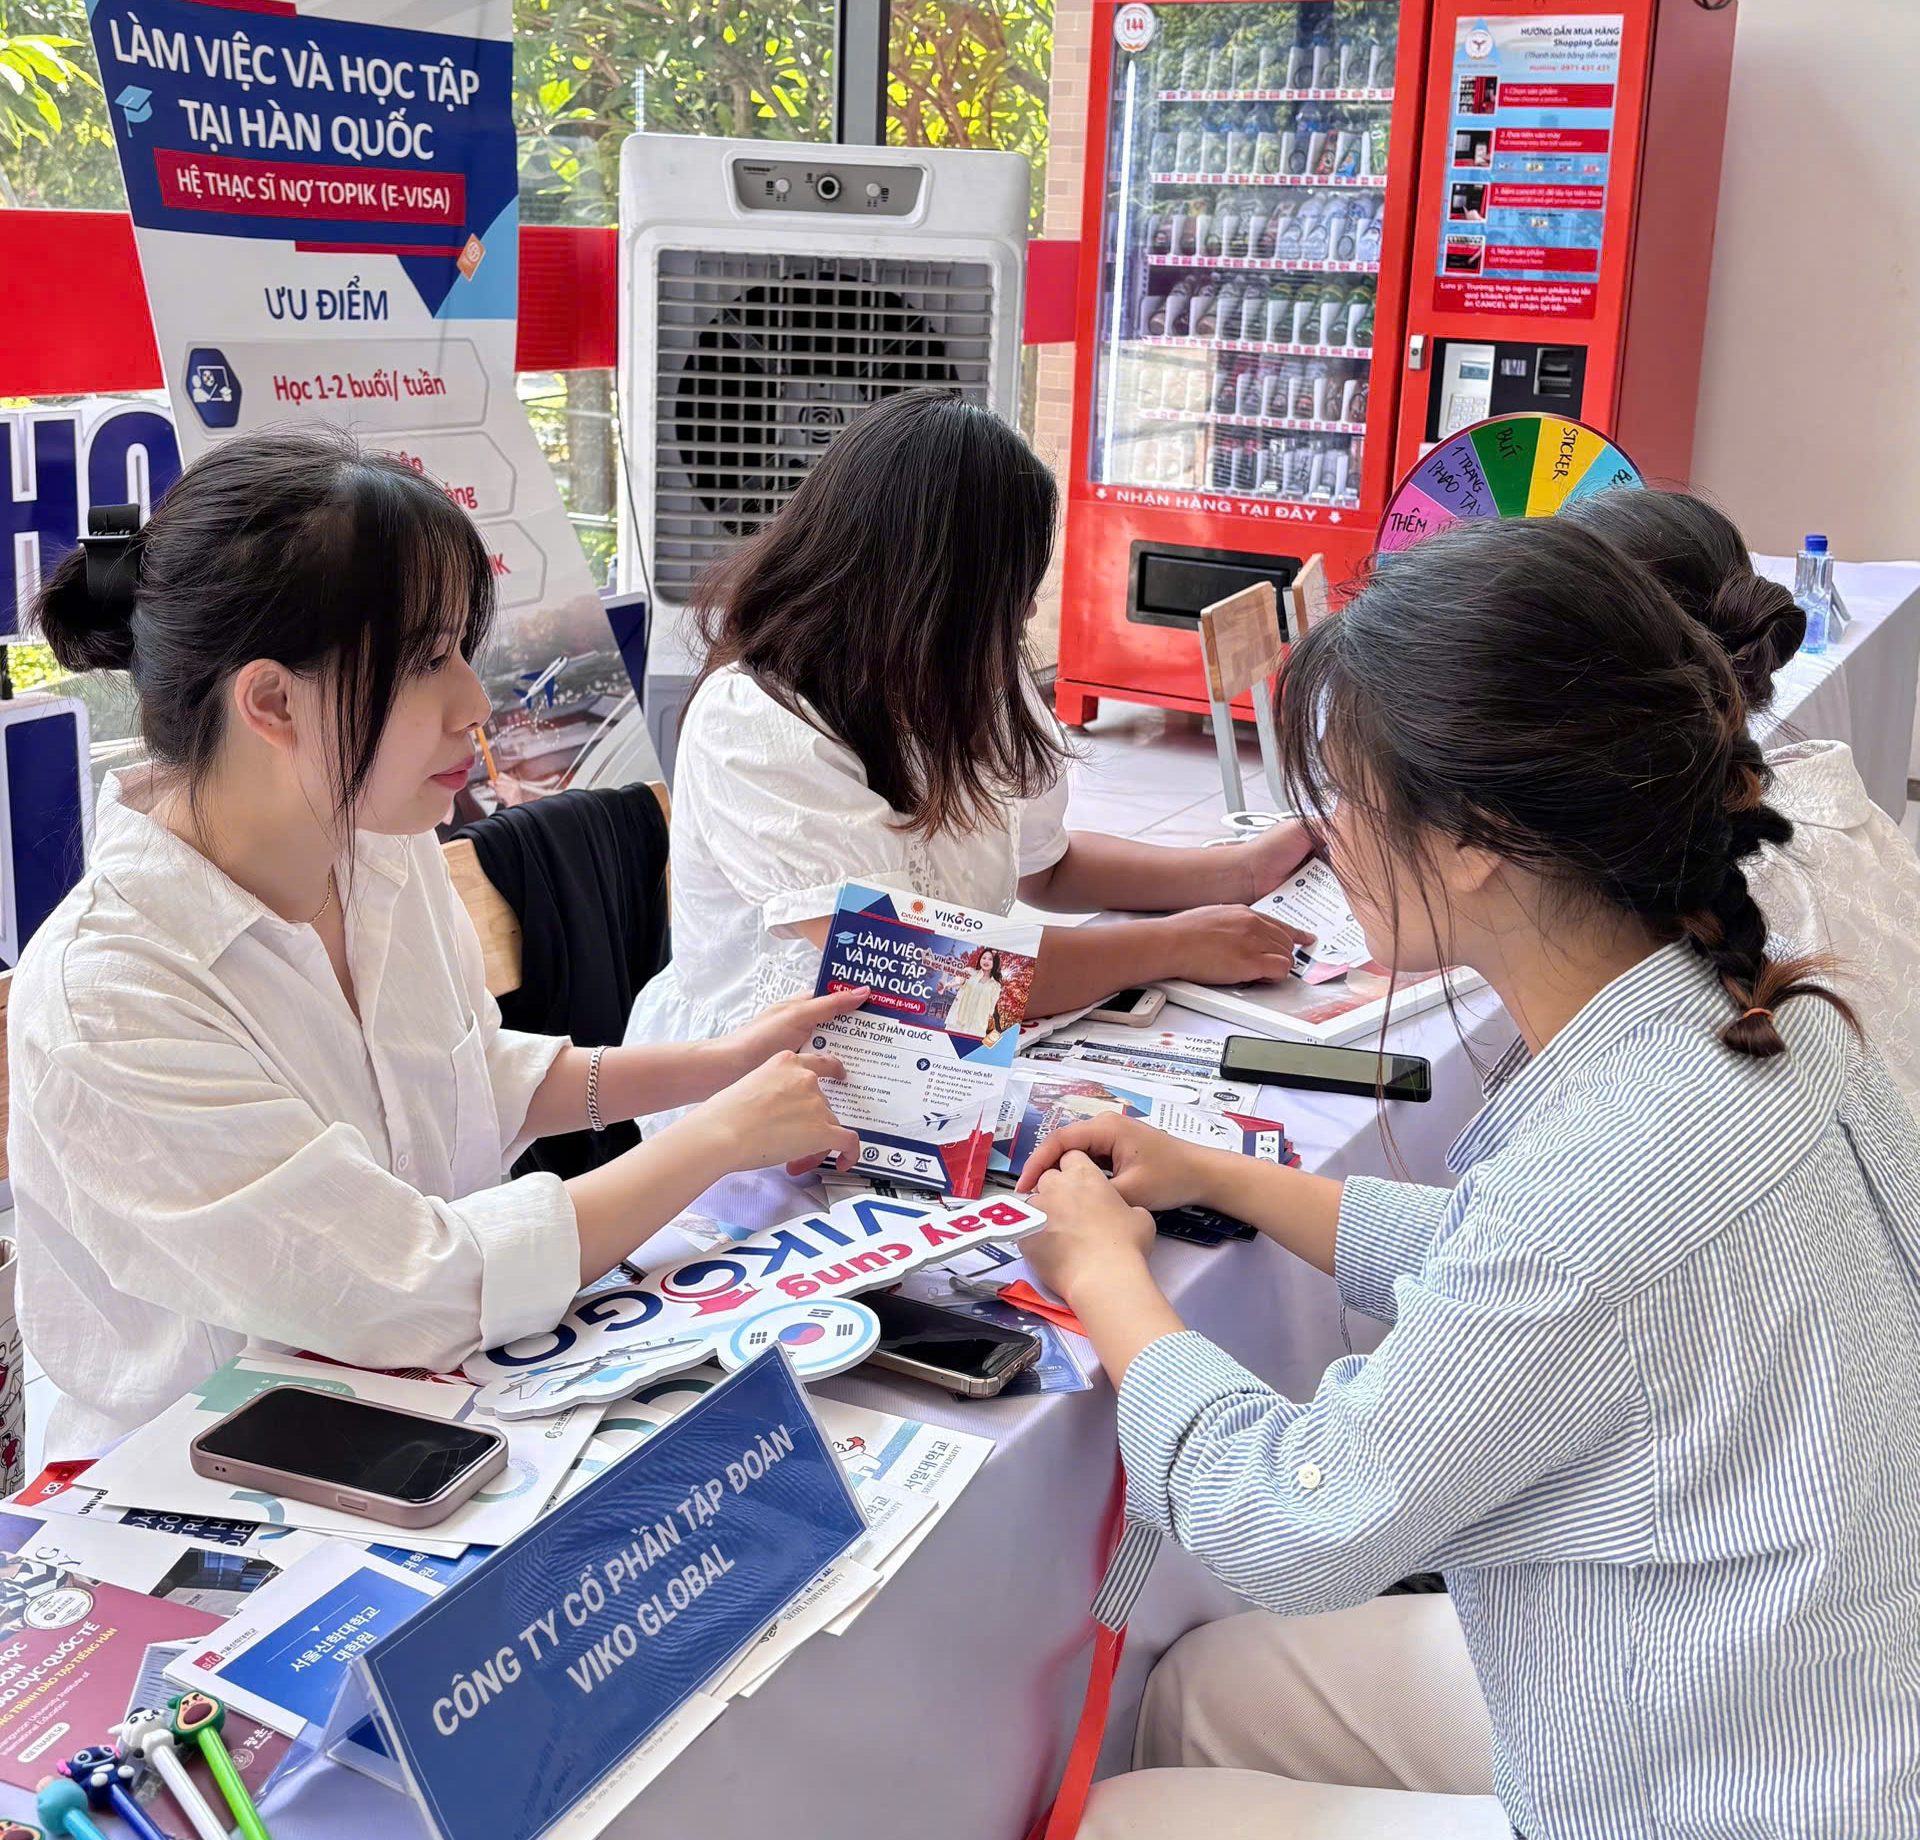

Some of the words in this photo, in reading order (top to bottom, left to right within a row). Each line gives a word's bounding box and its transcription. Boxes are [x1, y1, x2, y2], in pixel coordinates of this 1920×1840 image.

[109, 11, 191, 75] LÀM
[194, 30, 276, 92] VIỆC
[281, 40, 334, 92] VÀ
[340, 54, 416, 105] HỌC
[418, 56, 480, 112] TẬP
[1553, 39, 1592, 49] Shopping
[1594, 38, 1619, 47] Guide
[178, 98, 232, 153] TẠI
[238, 99, 322, 153] HÀN
[330, 107, 435, 161] QUỐC
[176, 164, 203, 198] HỆ
[204, 171, 256, 200] THẠC
[258, 171, 277, 202] SĨ
[280, 178, 316, 208] NỢ
[315, 180, 378, 206] TOPIK
[380, 183, 450, 214] (E-VISA)
[264, 286, 307, 320] ƯU
[315, 276, 388, 321] ĐIỂM
[273, 374, 313, 405] Học
[315, 374, 344, 400] 1-2
[349, 368, 399, 401] buổi/
[403, 368, 446, 397] tuần
[1552, 427, 1579, 480] STICKER
[1116, 490, 1169, 506] NHẬN
[1238, 502, 1269, 518] TẠI
[1391, 507, 1428, 533] THÊM
[935, 909, 983, 931] VIKOGO
[941, 922, 972, 933] GROUP
[845, 947, 864, 962] VÀ
[866, 955, 897, 974] HỌC
[901, 960, 927, 980] TẬP
[857, 931, 890, 952] LÀM
[892, 940, 922, 962] VIỆC
[831, 961, 851, 982] TẠI
[855, 966, 887, 989] HÀN
[887, 976, 933, 999] QUỐC
[878, 994, 896, 1005] TOPIK
[896, 998, 921, 1011] (E-VISA)
[849, 1025, 867, 1039] CẦN
[869, 1033, 893, 1044] TOPIK
[854, 1017, 877, 1031] THẠC
[878, 1021, 887, 1032] SĨ
[888, 1023, 908, 1036] HÀN
[909, 1029, 933, 1042] QUỐC
[922, 1202, 1031, 1248] Bay
[904, 1441, 950, 1489] 서일대학교
[432, 1645, 524, 1736] CÔNG
[519, 1611, 560, 1661] TY
[563, 1567, 606, 1627] CỔ
[602, 1514, 681, 1595] PHẦN
[676, 1478, 725, 1532] TẬP
[726, 1424, 796, 1495] ĐOÀN
[783, 1600, 808, 1622] SEOIL
[802, 1571, 846, 1606] UNIVERSITY
[290, 1605, 381, 1673] 서울신학대학교
[567, 1623, 638, 1695] VIKO
[637, 1544, 736, 1635] GLOBAL
[14, 1666, 48, 1691] DỤC
[42, 1635, 84, 1667] QUỐC
[76, 1620, 101, 1636] TẾ
[332, 1631, 378, 1664] 대학원
[11, 1691, 41, 1714] TRÌNH
[55, 1662, 76, 1677] TẠO
[70, 1642, 100, 1664] TIẾNG
[96, 1627, 118, 1643] HÀN
